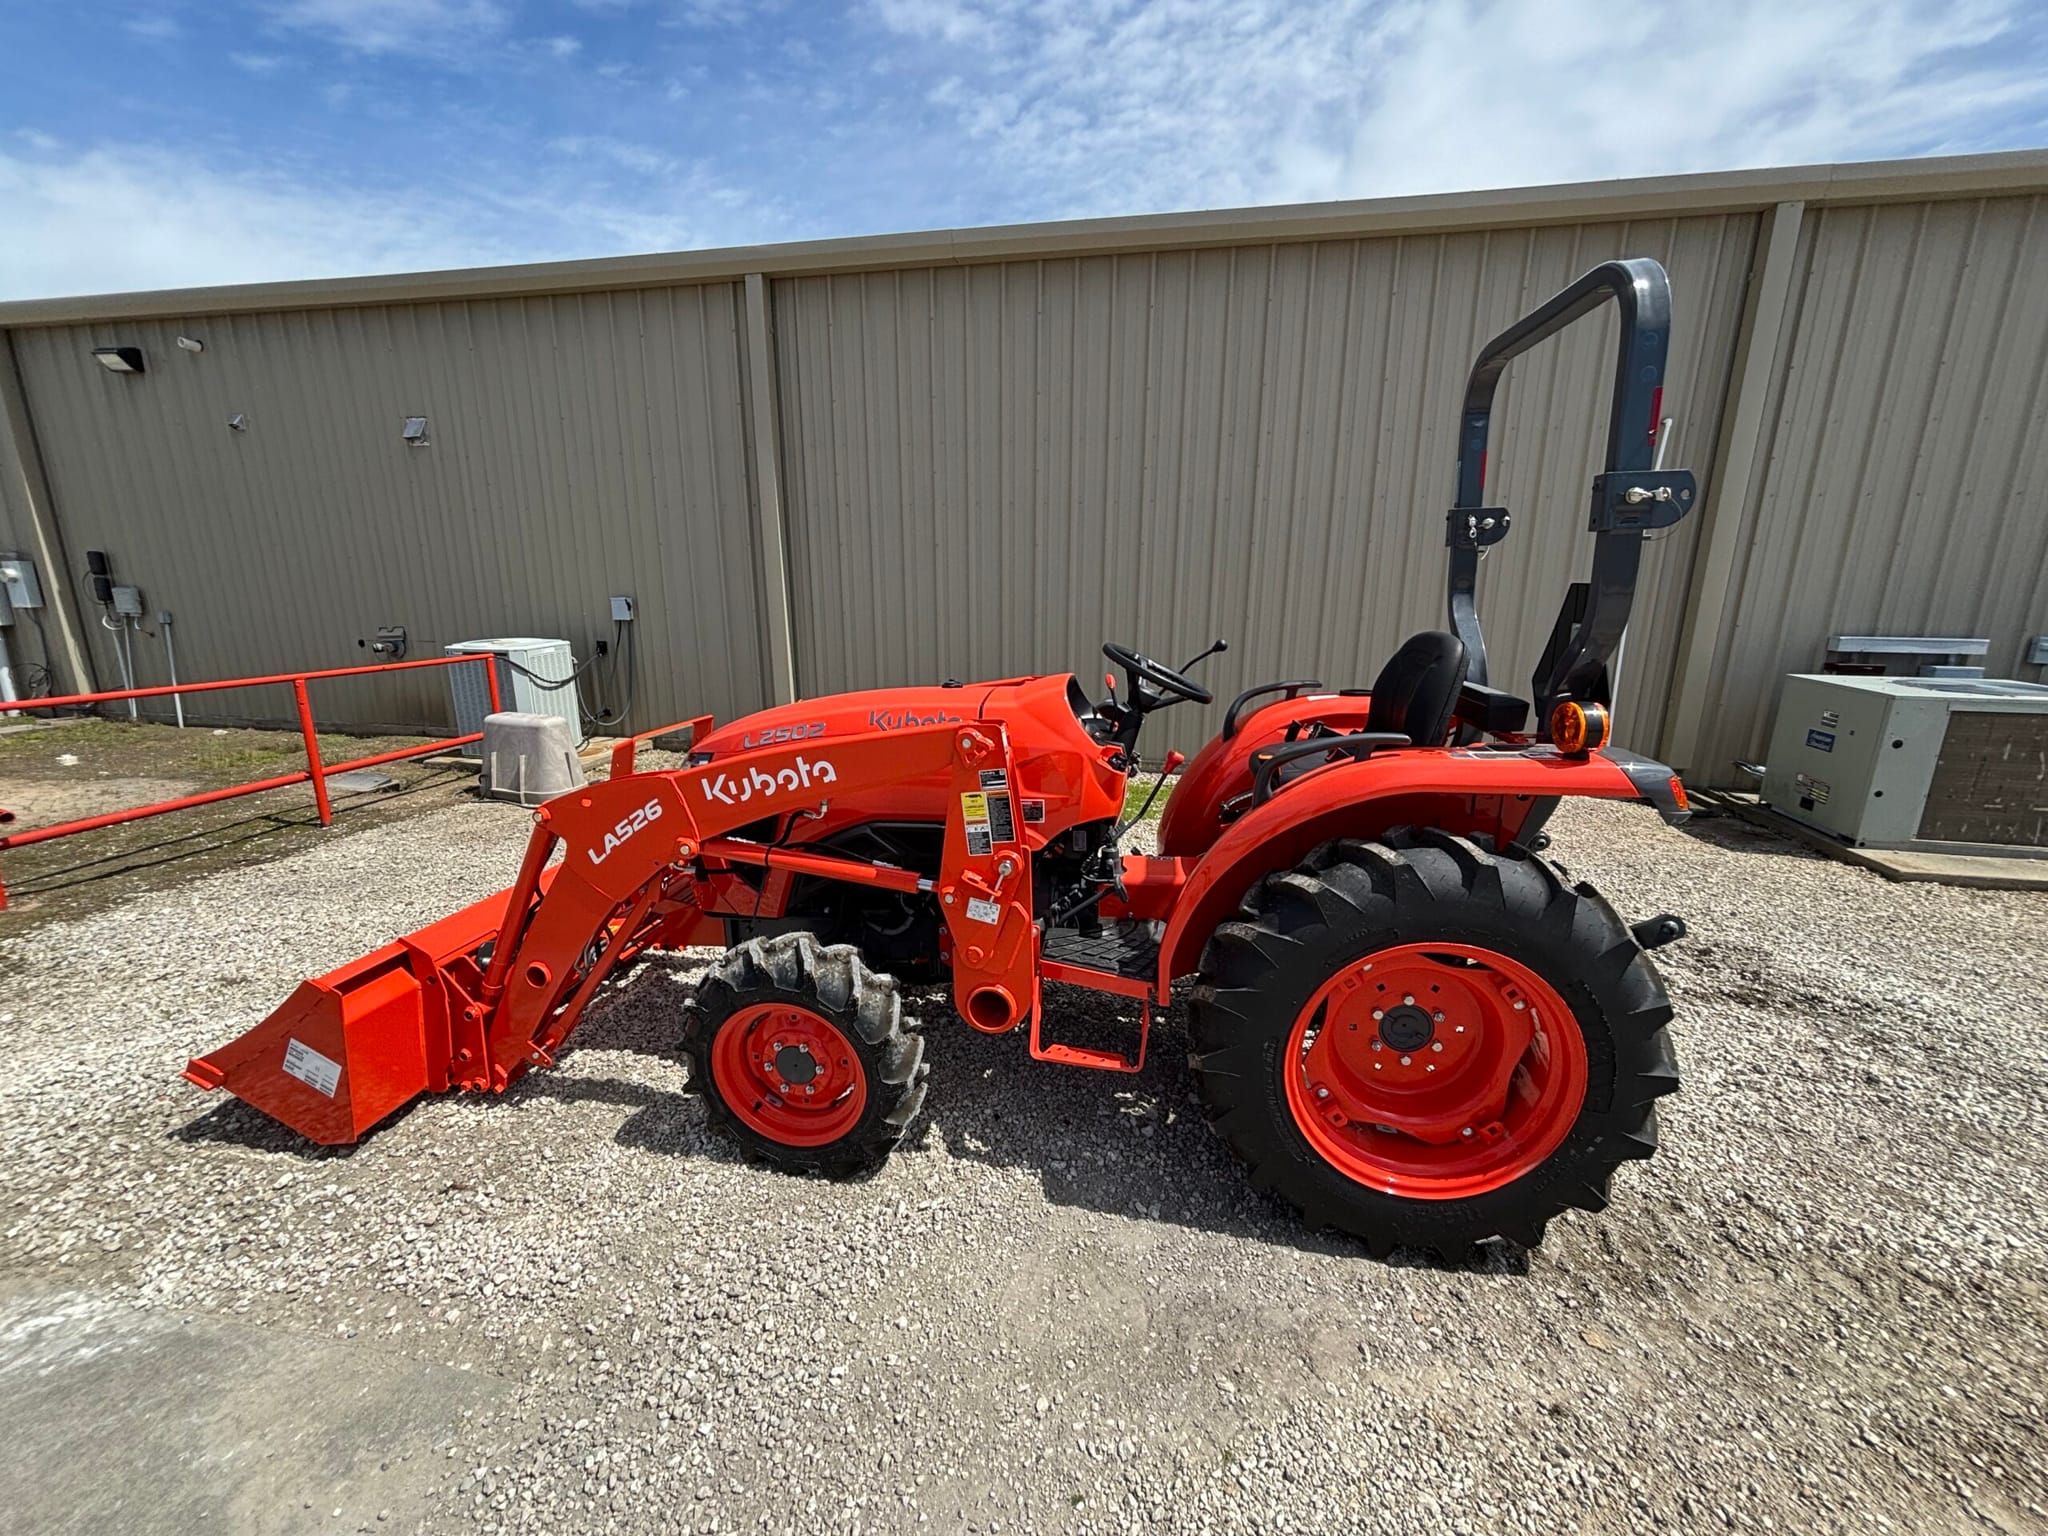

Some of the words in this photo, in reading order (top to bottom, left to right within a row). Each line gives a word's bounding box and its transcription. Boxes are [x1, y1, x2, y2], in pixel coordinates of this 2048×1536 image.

[743, 722, 827, 749] L2502
[701, 756, 838, 805] Kubota
[587, 798, 663, 865] LA526
